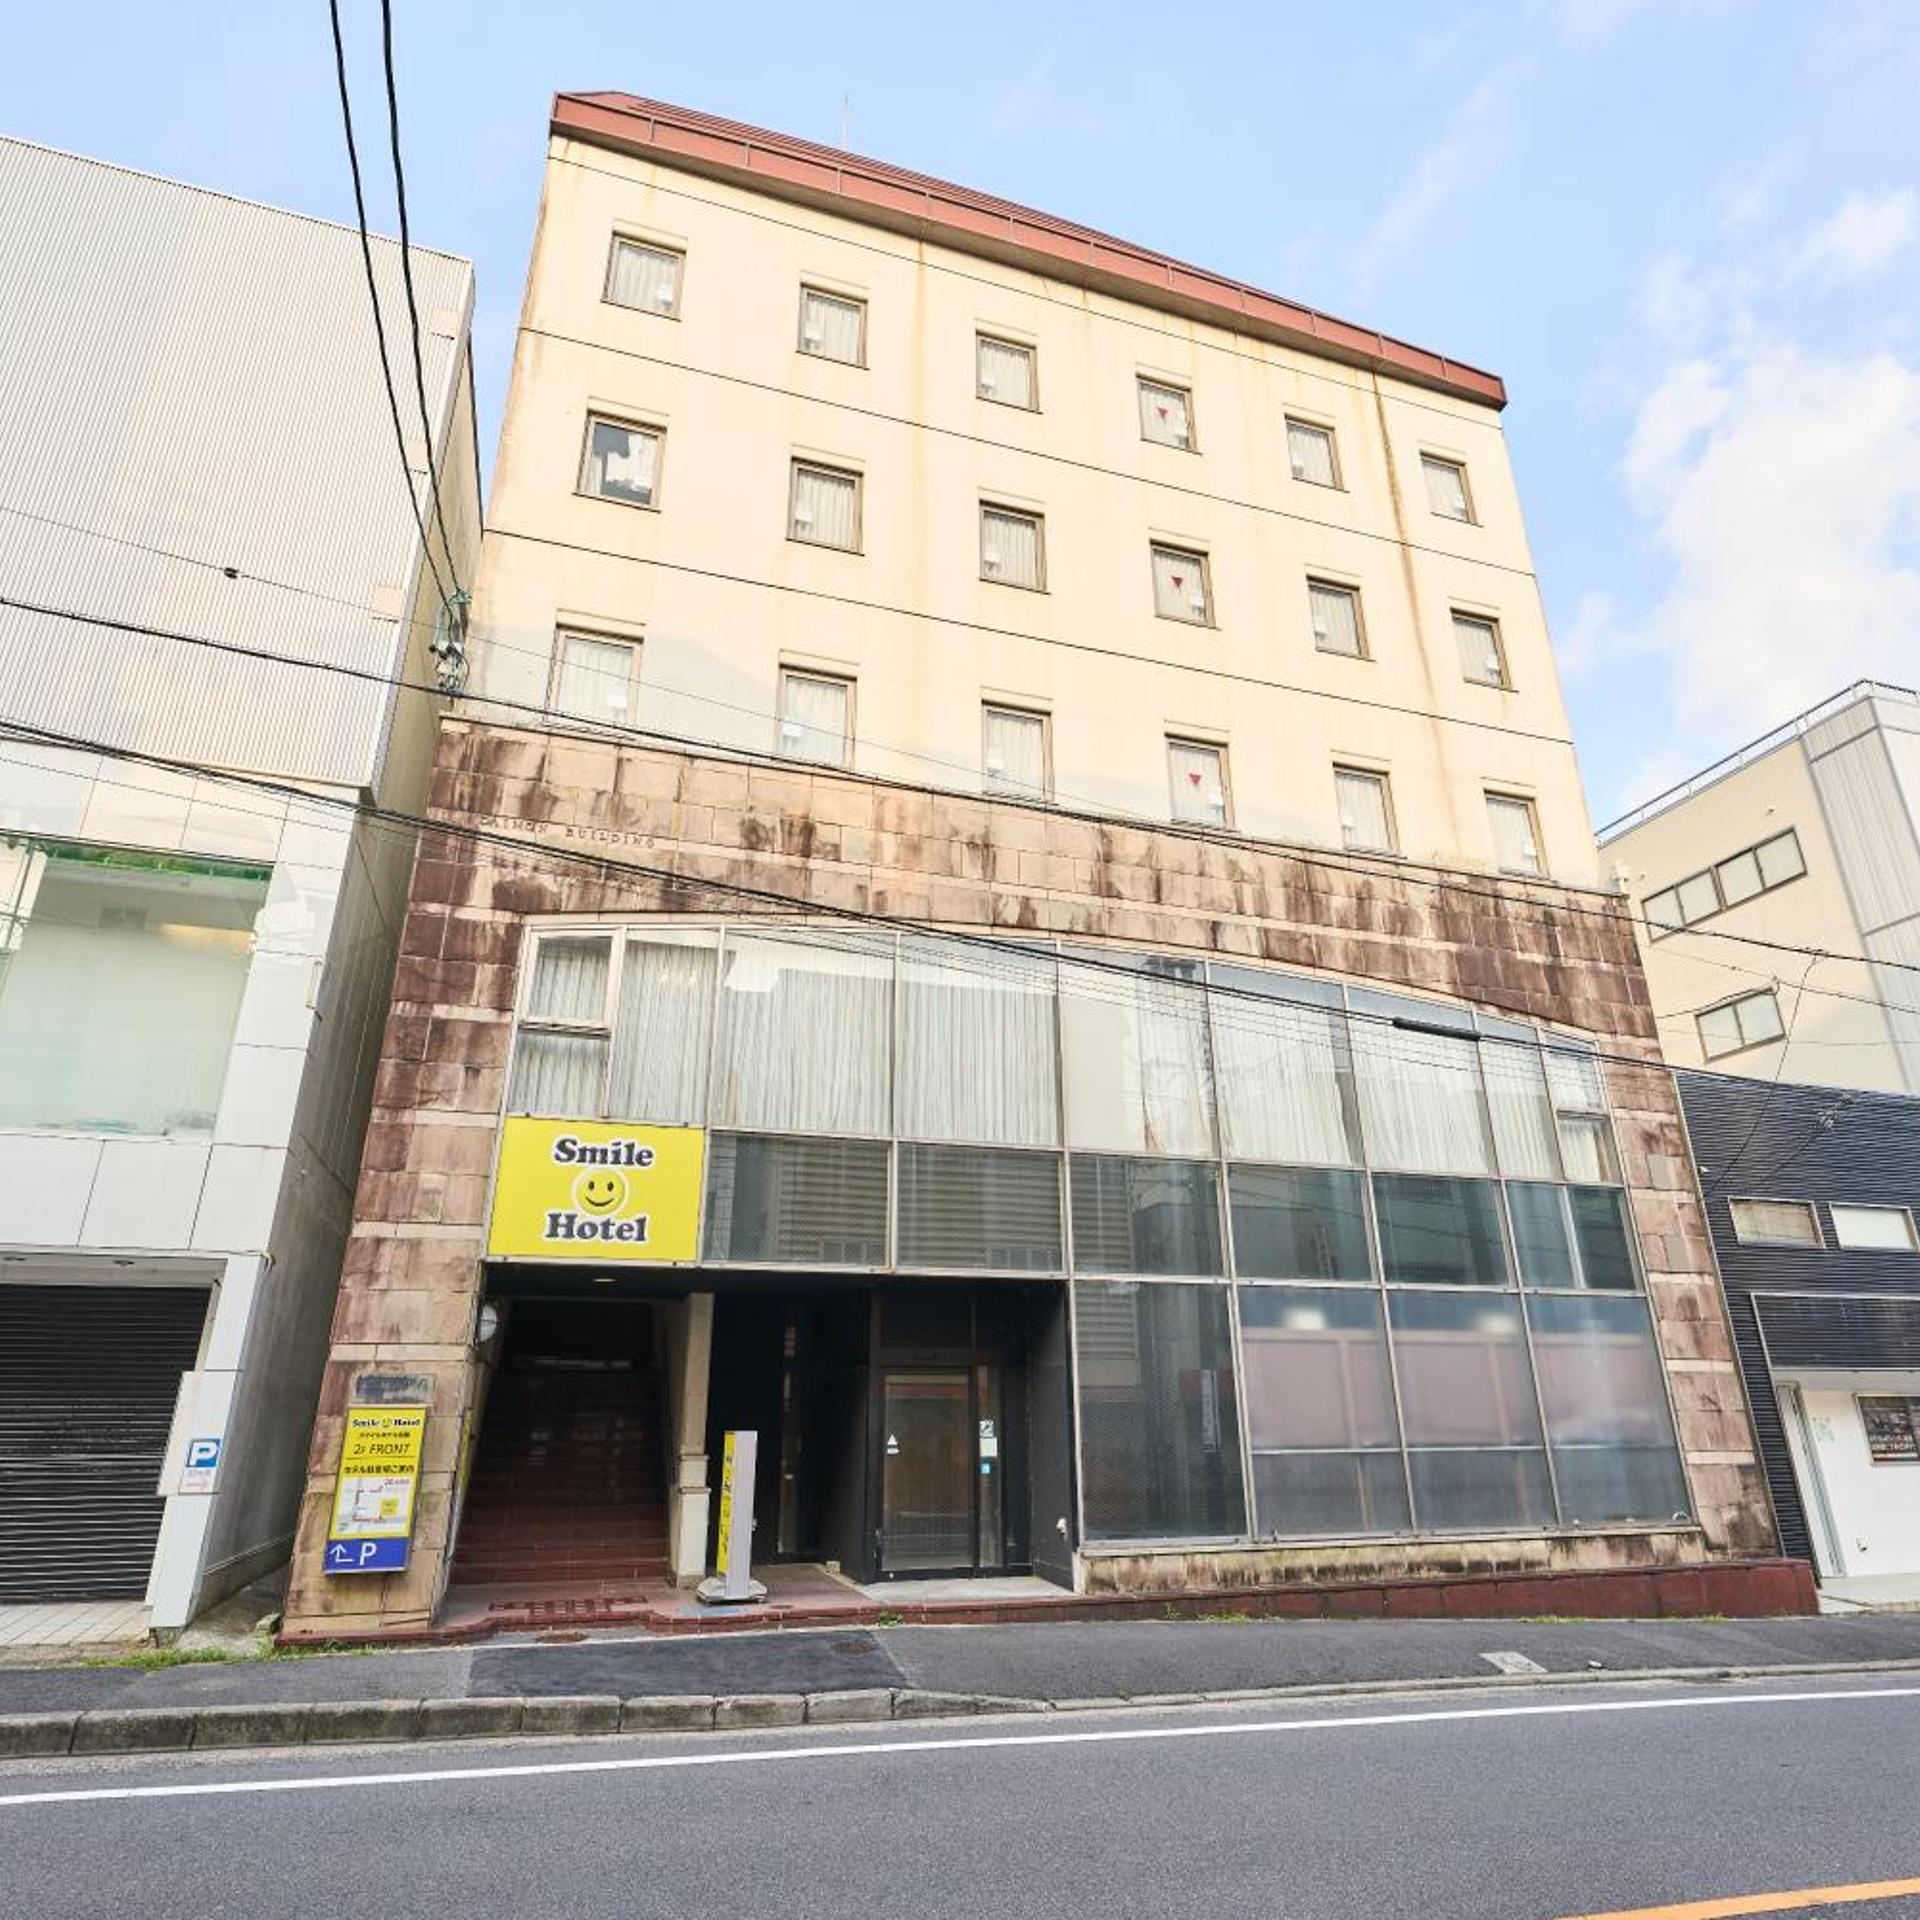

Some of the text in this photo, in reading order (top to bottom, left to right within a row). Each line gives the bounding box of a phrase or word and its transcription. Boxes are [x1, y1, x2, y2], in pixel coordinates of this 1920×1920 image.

[565, 825, 655, 848] BUILDING
[553, 1138, 654, 1166] Smile
[544, 1213, 647, 1242] Hotel
[352, 1418, 421, 1427] Smile Hotel
[189, 1441, 218, 1466] P
[369, 1443, 410, 1455] FRONT
[359, 1542, 377, 1566] P
